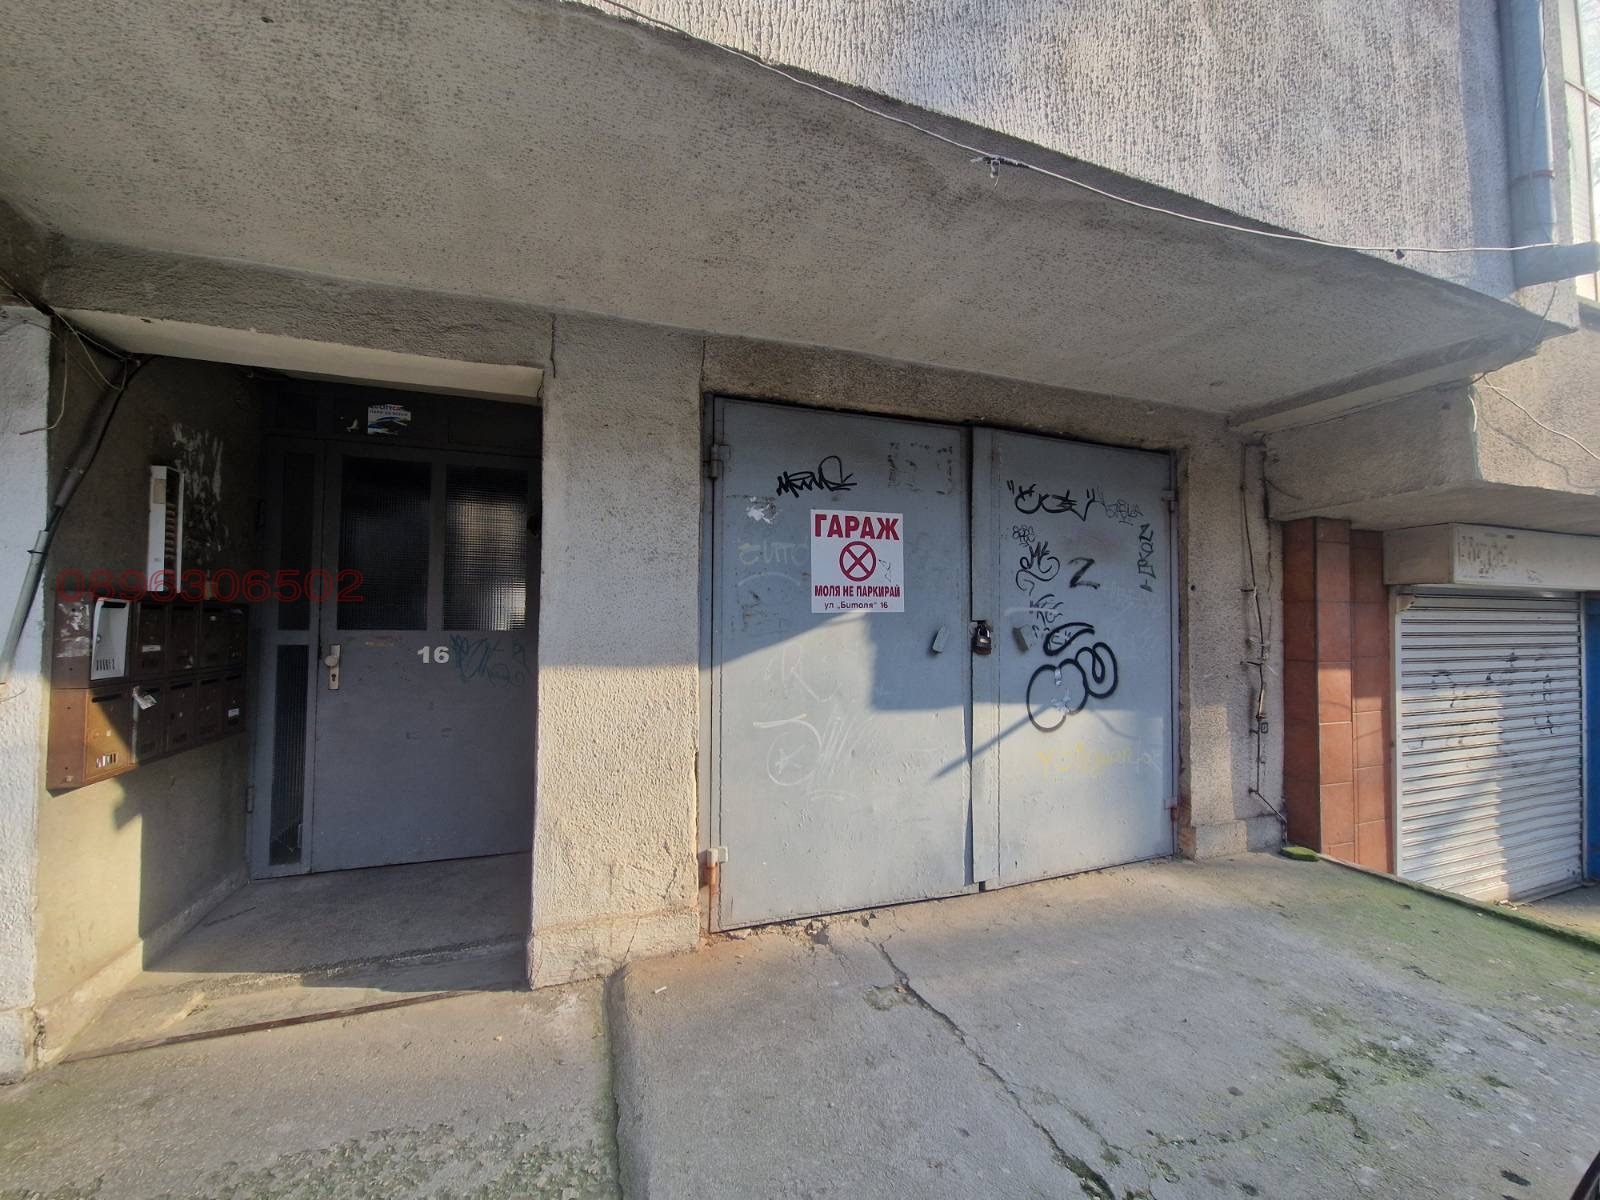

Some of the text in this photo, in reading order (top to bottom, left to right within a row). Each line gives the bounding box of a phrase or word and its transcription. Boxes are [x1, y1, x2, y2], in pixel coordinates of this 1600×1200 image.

[814, 513, 900, 541] ГАРАЖ
[814, 584, 900, 598] МОЛЯ НЕ ПАРКИРАЙ
[880, 601, 889, 609] 16
[417, 646, 450, 664] 16
